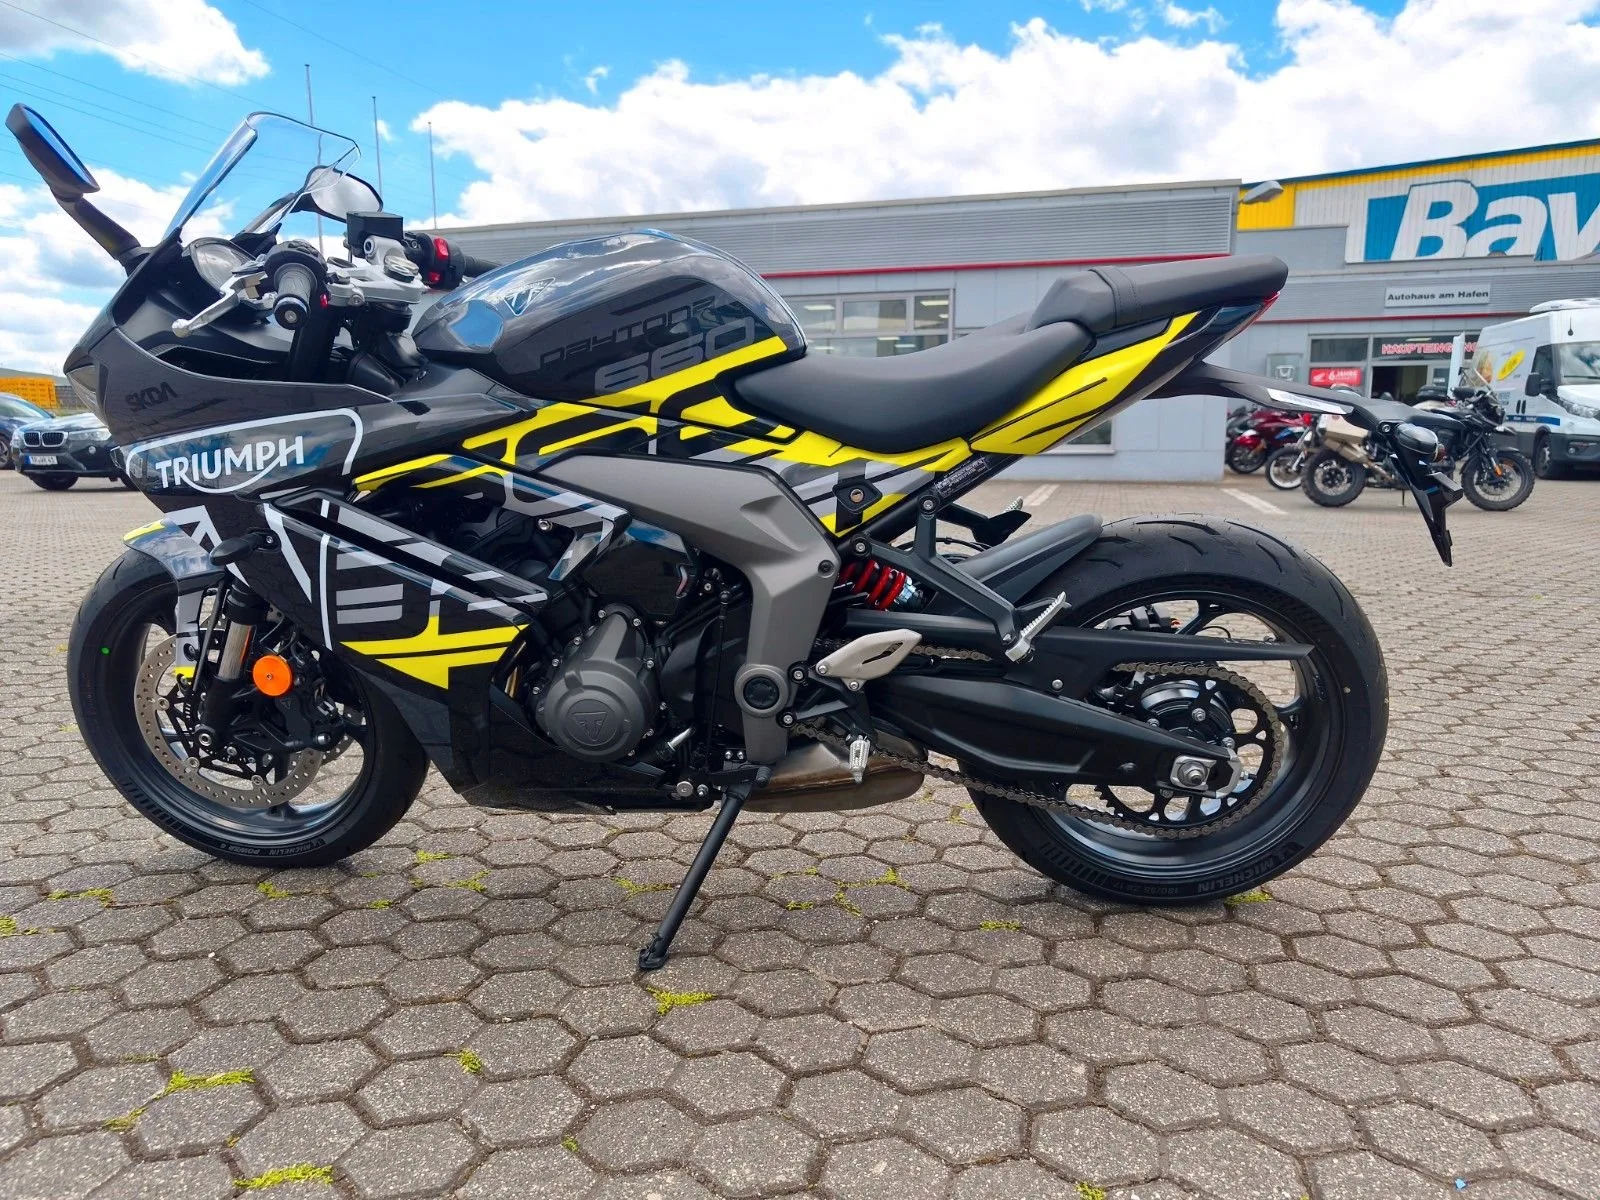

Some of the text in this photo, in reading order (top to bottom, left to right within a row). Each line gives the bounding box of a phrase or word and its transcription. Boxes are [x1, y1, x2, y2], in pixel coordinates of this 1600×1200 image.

[1457, 290, 1489, 298] Hafen
[594, 315, 755, 397] 660
[155, 436, 305, 494] TRIUMPH
[1198, 858, 1276, 893] MICHELIN
